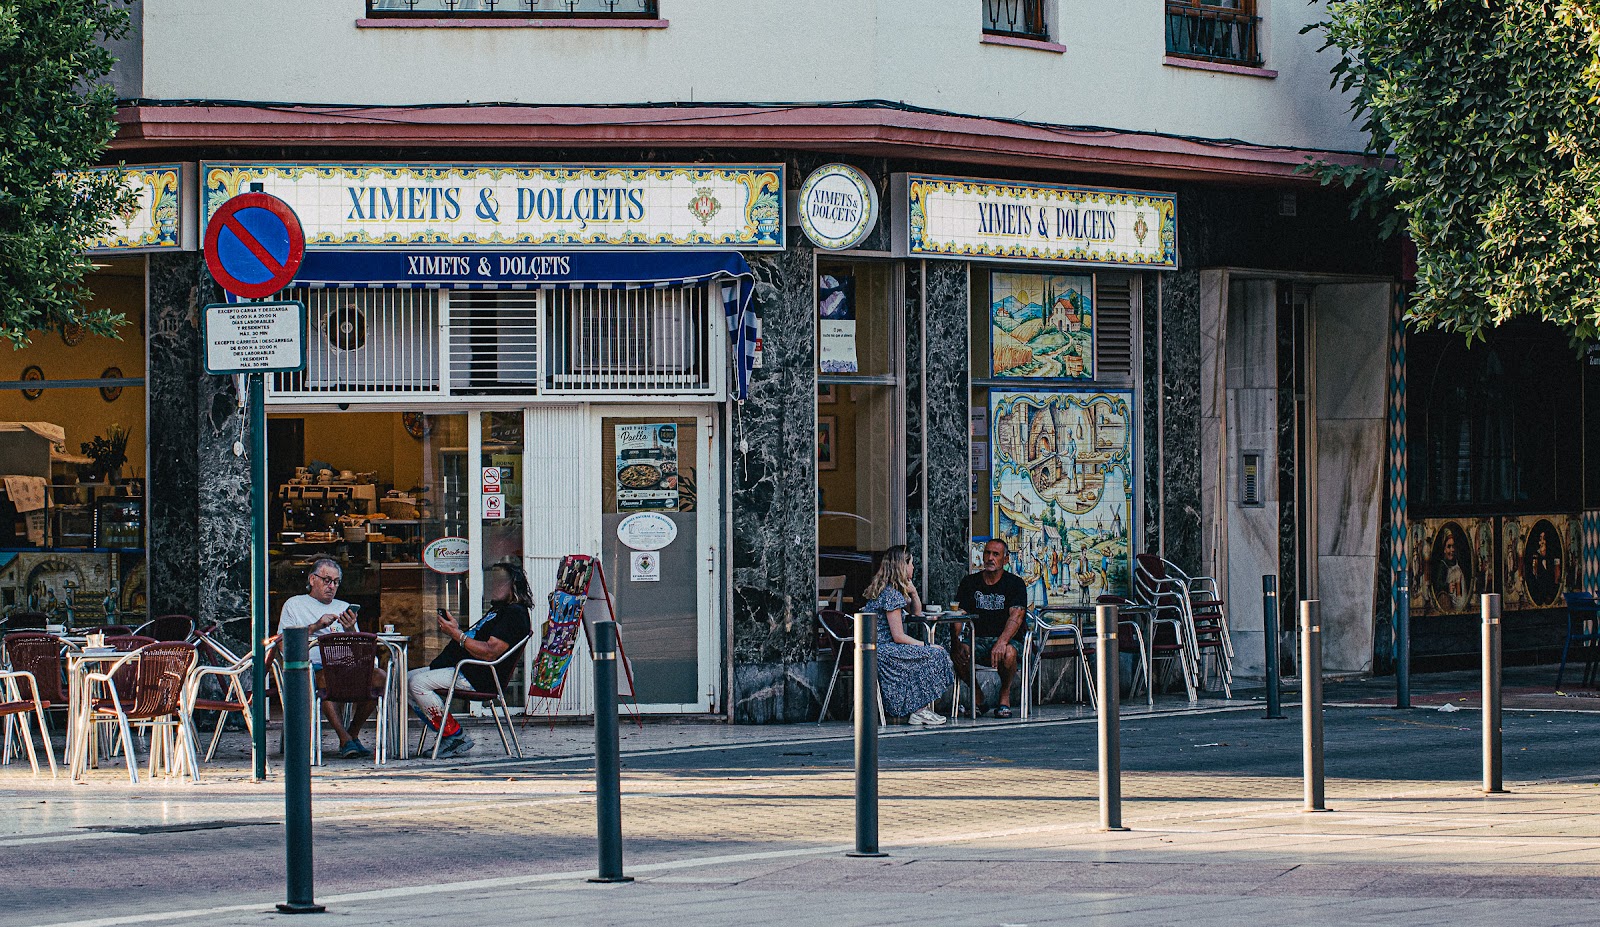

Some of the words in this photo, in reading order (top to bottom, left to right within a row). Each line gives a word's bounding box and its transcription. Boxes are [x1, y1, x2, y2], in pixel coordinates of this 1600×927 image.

[346, 187, 462, 222] XIMETS
[475, 187, 502, 224] &
[515, 187, 646, 232] DOLÇETS
[812, 203, 857, 224] DOLÇETS
[977, 202, 1032, 238] XIMETS
[1038, 206, 1050, 242] &
[1056, 207, 1116, 250] DOLÇETS
[407, 255, 471, 276] XIMETS
[477, 256, 492, 277] &
[499, 256, 571, 281] DOLÇETS
